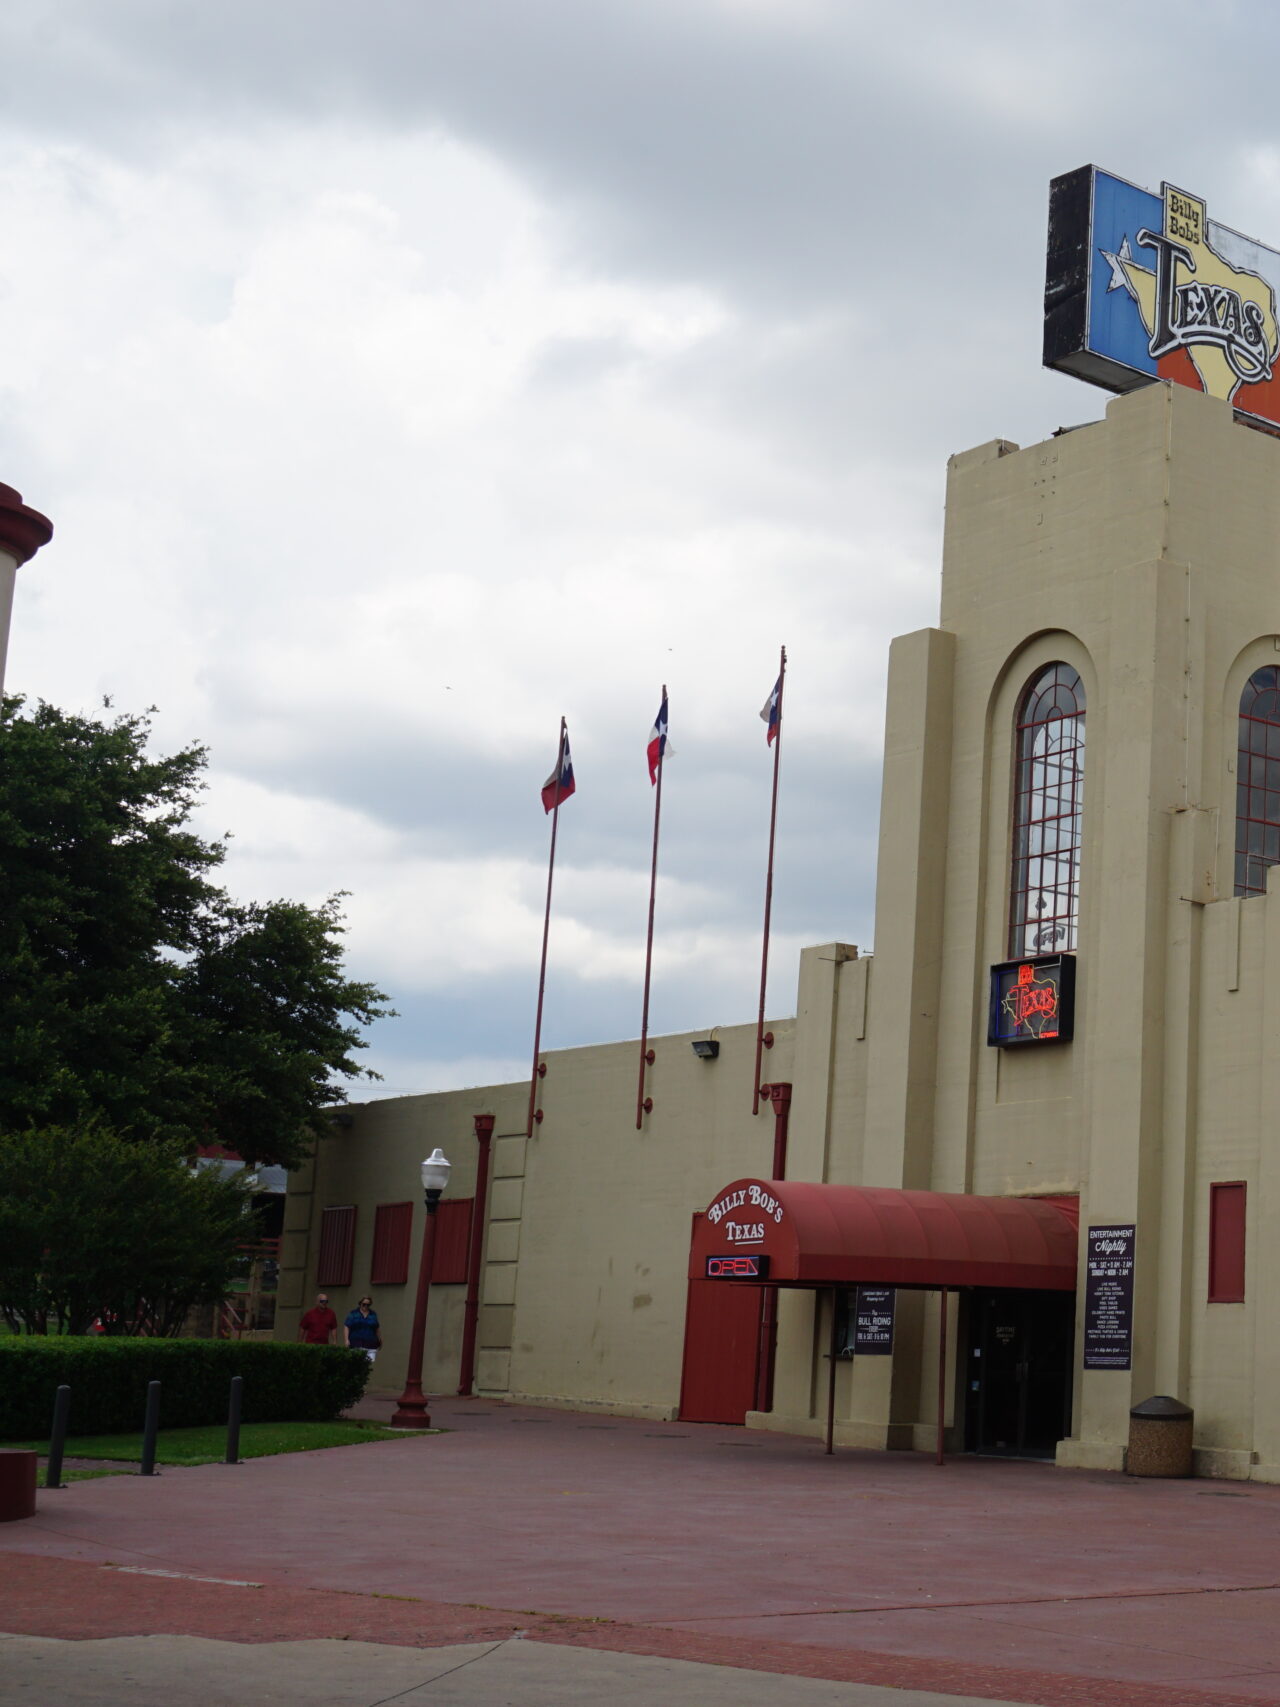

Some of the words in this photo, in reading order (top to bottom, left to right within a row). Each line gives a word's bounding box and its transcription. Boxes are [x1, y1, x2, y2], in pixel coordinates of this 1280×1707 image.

[1170, 193, 1200, 229] Billy
[1169, 215, 1200, 245] Bobs
[1136, 227, 1270, 362] TEXAS
[708, 1190, 746, 1224] BILLY
[749, 1185, 783, 1223] BOB'S
[726, 1222, 764, 1240] TEXAS
[1090, 1230, 1133, 1239] ENTERTAINMENT
[1095, 1239, 1127, 1255] Nightly
[709, 1258, 758, 1275] OPEN
[858, 1317, 871, 1325] BULL
[873, 1317, 891, 1325] RIDING
